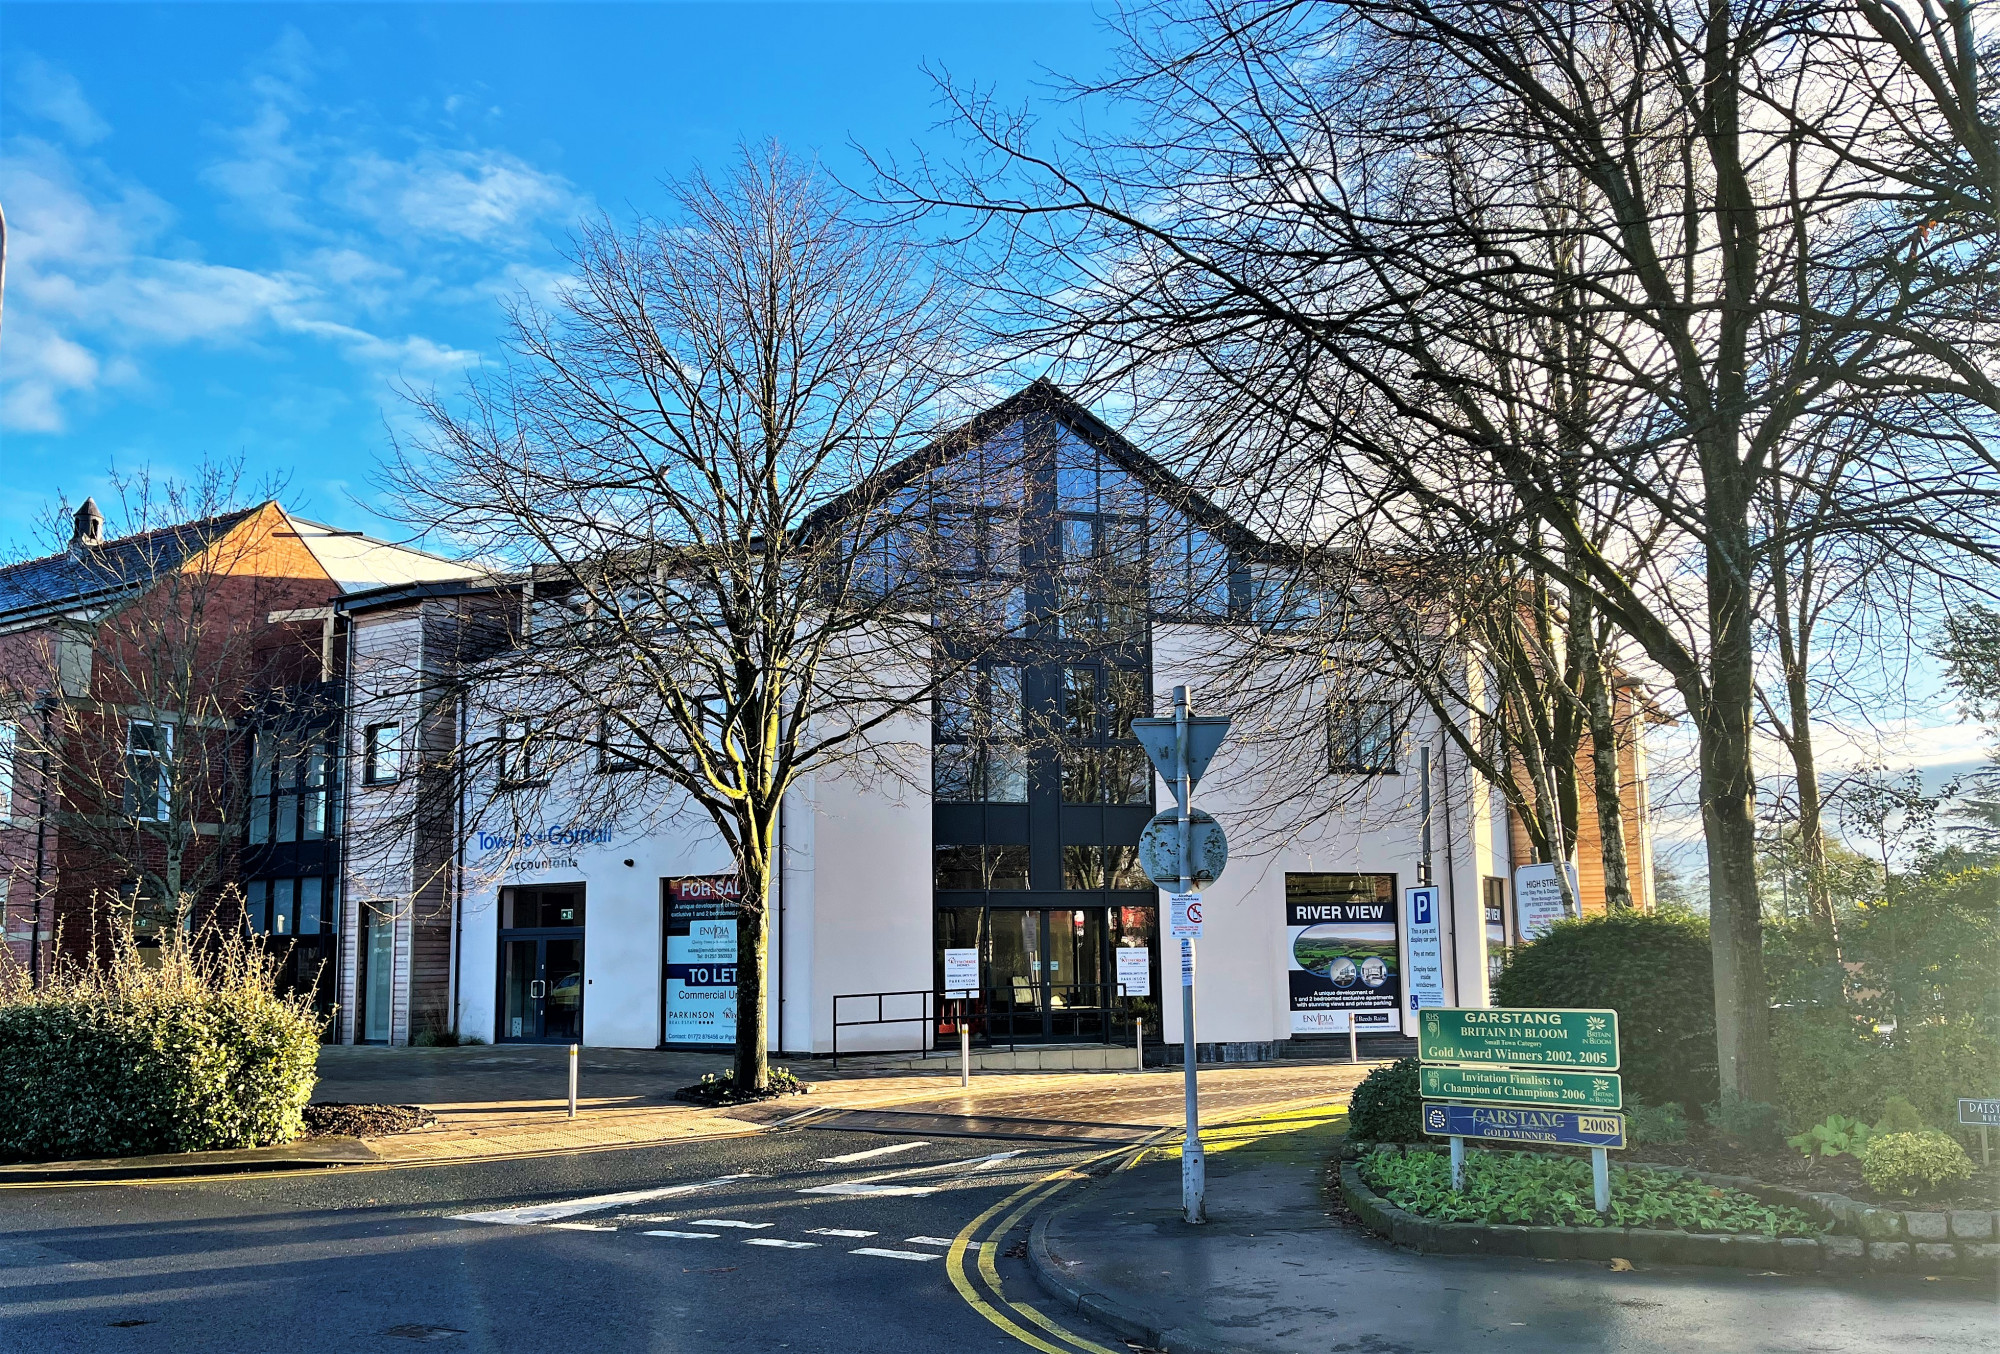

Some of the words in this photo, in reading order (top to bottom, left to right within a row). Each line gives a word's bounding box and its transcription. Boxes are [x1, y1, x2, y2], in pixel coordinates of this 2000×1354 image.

[477, 831, 533, 850] Tows
[507, 858, 578, 870] Accountants
[681, 882, 711, 897] FOR
[715, 881, 741, 896] SAL
[1526, 879, 1541, 889] HIGH
[1541, 878, 1559, 888] STRE
[1296, 905, 1342, 920] RIVER
[1345, 905, 1384, 919] VIEW
[1417, 896, 1427, 921] P
[700, 925, 729, 938] ENVIDIA
[689, 968, 709, 983] TO
[713, 968, 738, 983] LET
[1413, 965, 1427, 973] Display
[679, 990, 727, 1000] Commercial
[669, 1011, 715, 1019] PARKINSON
[1303, 1013, 1334, 1025] ENVIDIA
[1464, 1012, 1562, 1025] GARSTANG
[1460, 1026, 1506, 1037] BRITAIN
[1509, 1027, 1522, 1038] IN
[1524, 1028, 1568, 1039] BLOOM
[1586, 1030, 1612, 1038] BRITAIN
[1589, 1037, 1612, 1045] BLOOM
[1428, 1046, 1454, 1058] Gold
[1457, 1047, 1492, 1059] Award
[1494, 1048, 1543, 1061] Winners
[1545, 1050, 1576, 1065] 2002,
[1579, 1051, 1608, 1064] 2005
[1462, 1072, 1507, 1084] Invitation
[1510, 1074, 1551, 1086] Finalists
[1553, 1076, 1564, 1086] to
[1443, 1082, 1490, 1096] Champion
[1492, 1085, 1502, 1095] of
[1504, 1085, 1559, 1099] Champions
[1561, 1089, 1586, 1100] 2006
[1592, 1090, 1614, 1098] BRITAIN
[1595, 1096, 1615, 1104] BLOOM
[1969, 1103, 2000, 1113] DAISY
[1472, 1108, 1565, 1128] GARSTANG
[1582, 1118, 1616, 1133] 2008
[1483, 1128, 1511, 1138] GOLD
[1512, 1130, 1557, 1141] WINNERS
